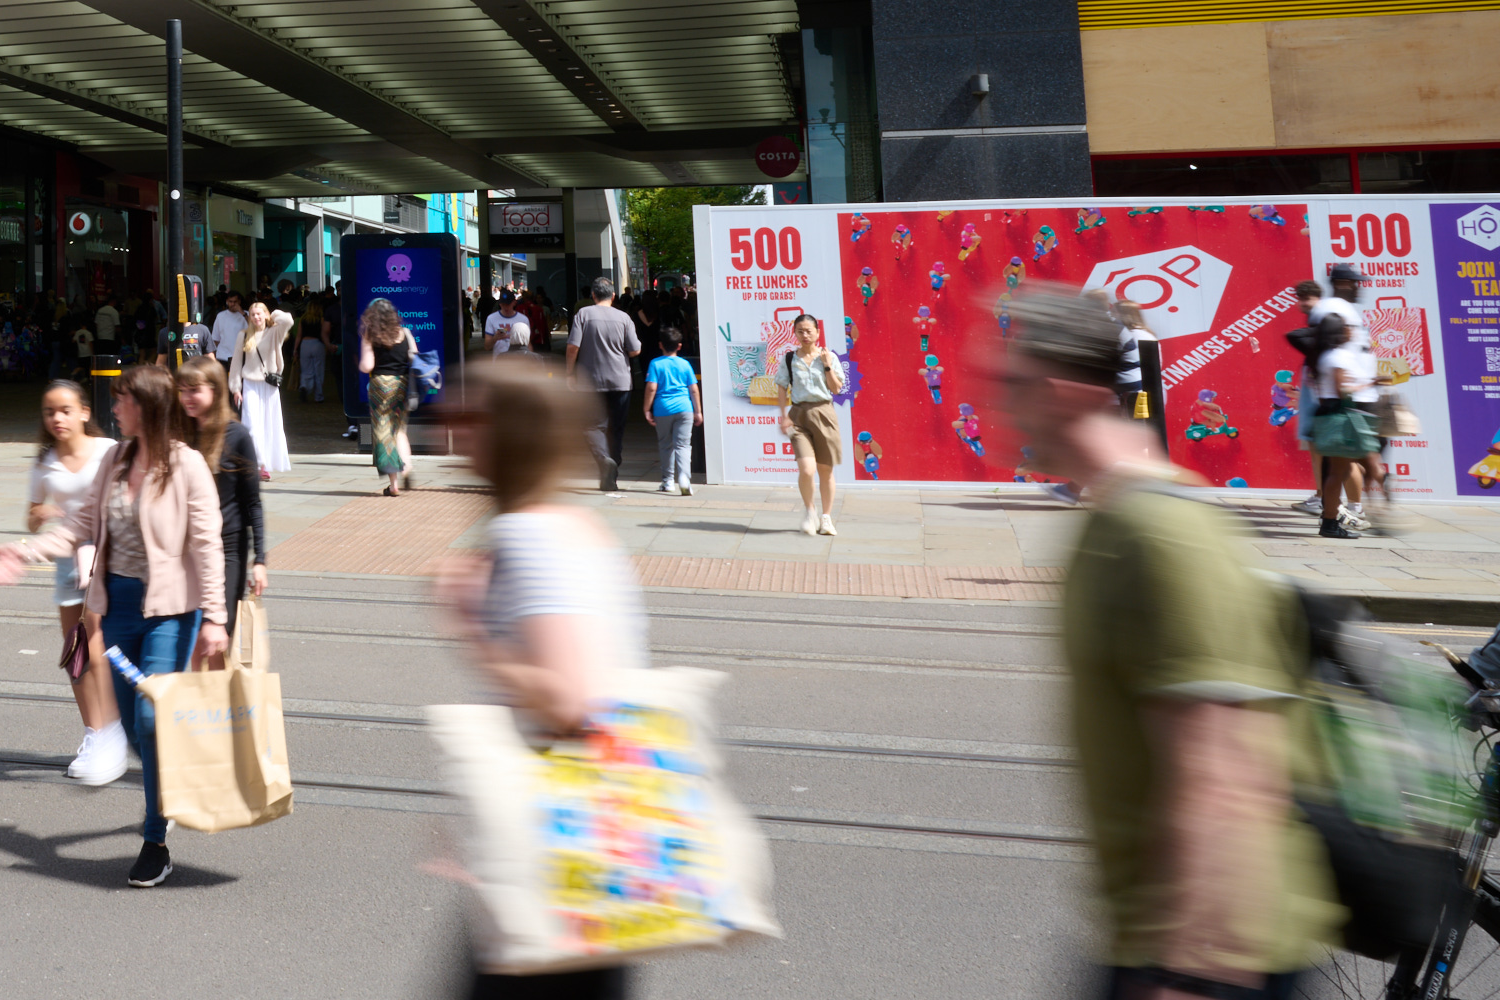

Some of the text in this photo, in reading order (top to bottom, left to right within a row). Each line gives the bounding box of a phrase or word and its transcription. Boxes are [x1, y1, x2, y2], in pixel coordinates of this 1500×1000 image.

[759, 152, 796, 161] COSTA
[502, 205, 550, 226] food
[1329, 212, 1412, 258] 500
[729, 226, 802, 271] 500
[1360, 262, 1419, 276] LUNCHES
[1457, 261, 1496, 278] JOIN
[726, 275, 808, 290] FREE LUNCHES
[1375, 279, 1405, 288] GRABS!
[1471, 279, 1500, 296] TEA
[371, 286, 429, 294] octopus energy
[742, 292, 796, 301] UP FOR GRABS!
[397, 309, 428, 318] homes
[1221, 305, 1277, 343] STREET
[1265, 286, 1299, 313] EATS
[415, 321, 436, 330] with
[726, 416, 744, 425] SCAN
[747, 416, 756, 425] TO
[758, 416, 775, 425] SIGN
[1405, 440, 1429, 448] YOURS!
[173, 704, 257, 726] PRIMARK
